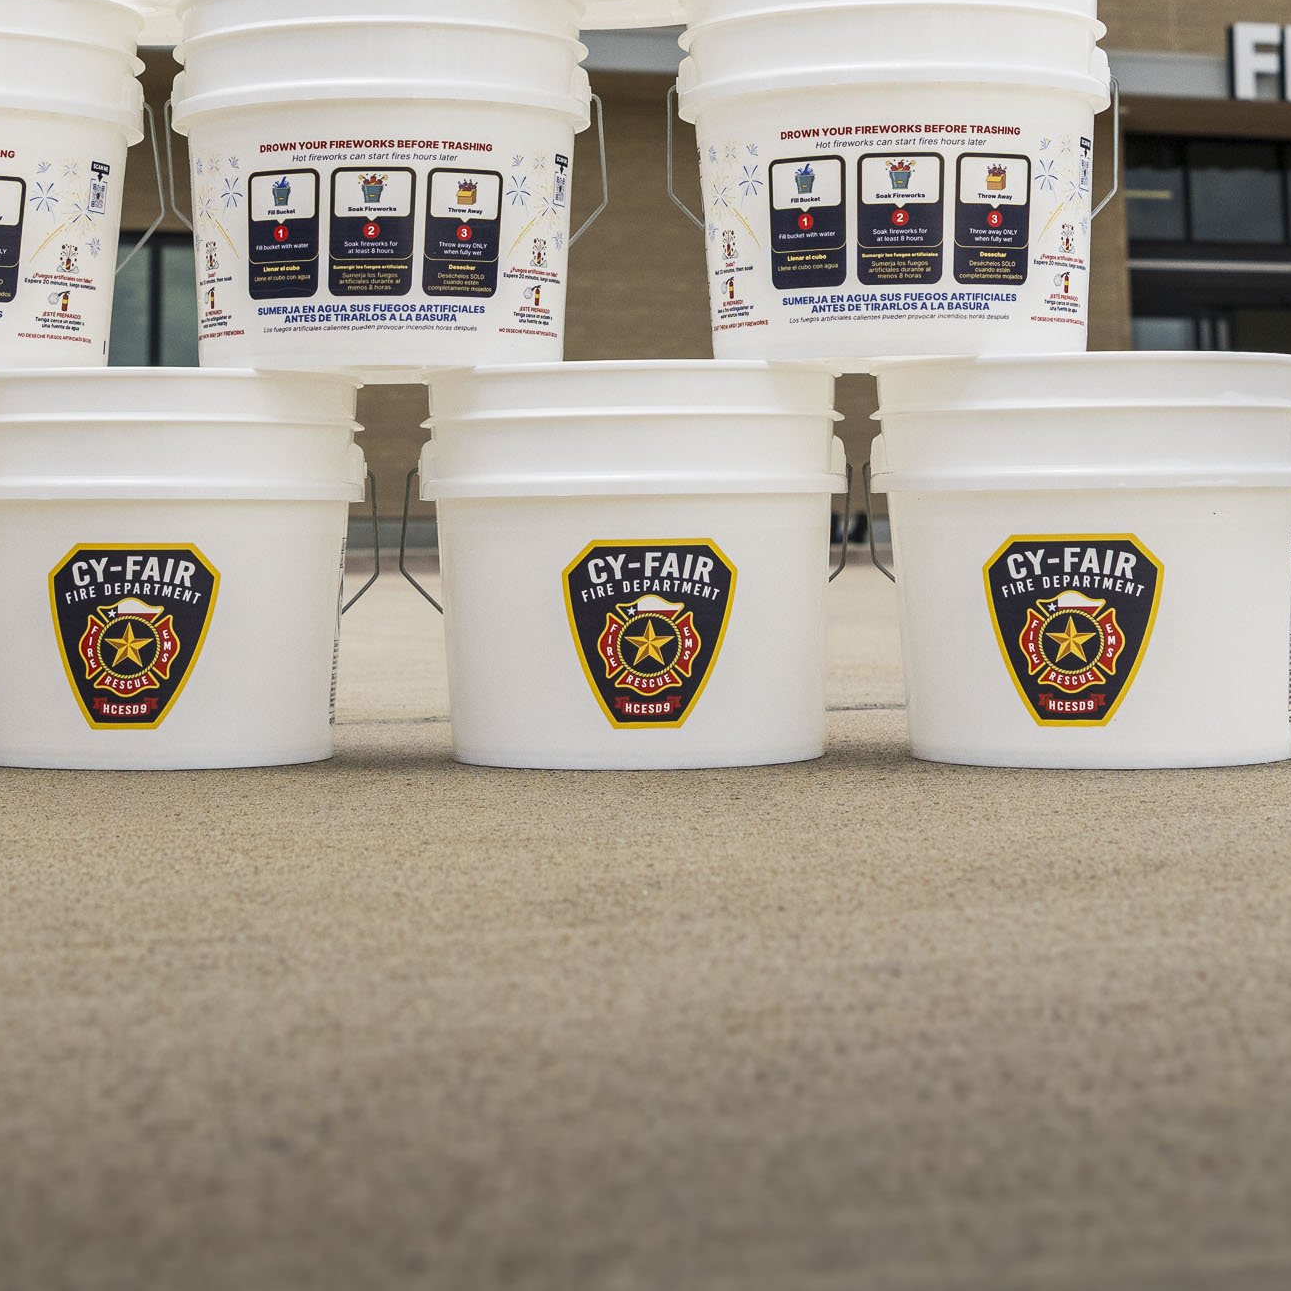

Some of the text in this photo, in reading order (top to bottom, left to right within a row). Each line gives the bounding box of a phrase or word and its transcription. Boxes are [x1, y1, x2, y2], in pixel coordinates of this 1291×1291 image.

[781, 125, 1020, 140] DROWN YOUR FIREWORKS BEFORE TRASHING
[260, 140, 492, 153] DROWN YOUR FIREWORKS BEFORE TRASHING
[803, 217, 807, 226] 1
[897, 213, 903, 222] 2
[992, 215, 998, 223] 3
[278, 229, 282, 237] 1
[368, 226, 374, 235] 2
[461, 229, 467, 237] 3
[783, 293, 1016, 305] SUMERJA EN AGUA SUS FUEGOS ARTIFICIALES
[258, 304, 485, 315] SUMERJA EN AGUA SUS FUEGOS ARTIFICIALES
[812, 304, 845, 313] ANTES
[864, 302, 917, 311] TIRARLOS
[920, 302, 928, 310] A
[931, 302, 944, 310] LA
[947, 302, 989, 310] BASURA
[284, 313, 457, 323] ANTES DE TIRARLOS A LA BASURA
[587, 551, 714, 584] CY-FAIR
[1007, 546, 1137, 579] CY-FAIR
[72, 555, 196, 586] CY-FAIR
[65, 582, 202, 605] FIRE DEPARTMENT
[582, 579, 721, 603] FIRE DEPARTMENT
[1002, 575, 1145, 598] FIRE DEPARTMENT
[87, 626, 98, 668] FIRE
[161, 629, 171, 662] EMS
[606, 624, 618, 667] FIRE
[683, 627, 693, 660] EMS
[1028, 620, 1039, 665] FIRE
[1106, 623, 1116, 658] EMS
[104, 675, 148, 689] RESCUE
[626, 674, 671, 688] RESCUE
[1049, 671, 1095, 686] RESCUE
[103, 703, 147, 715] HCESD9
[625, 703, 670, 714] HCESD9
[1049, 700, 1094, 711] HCESD9
